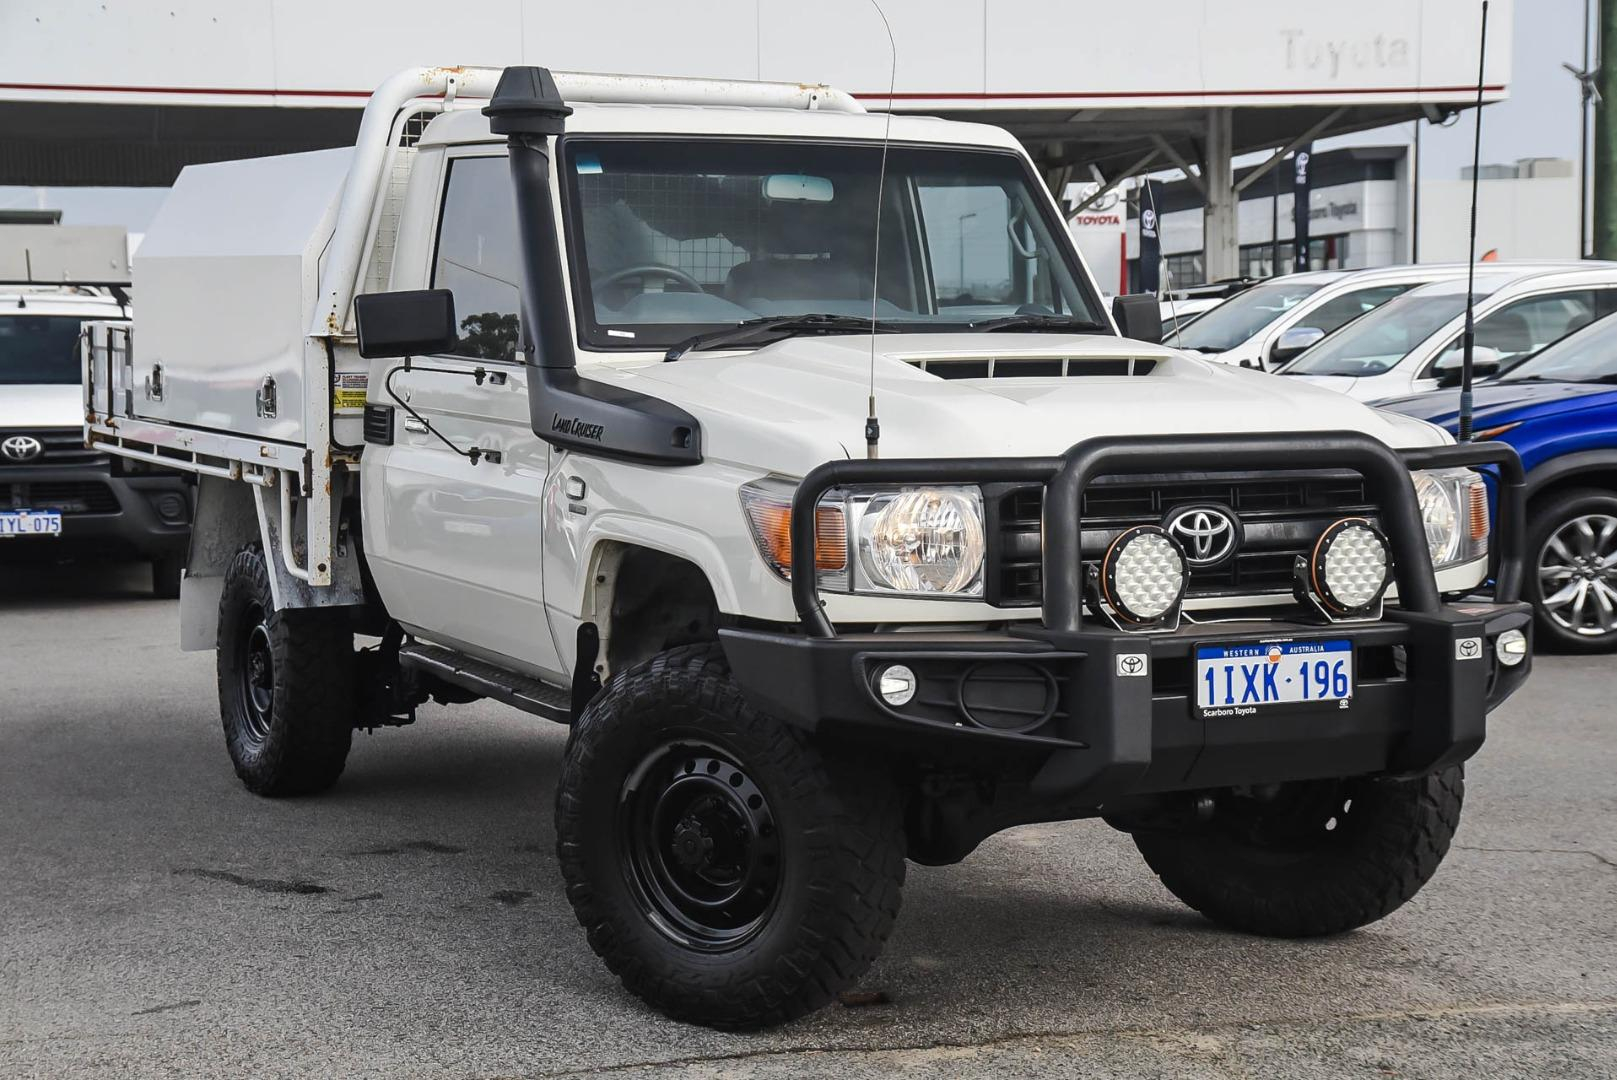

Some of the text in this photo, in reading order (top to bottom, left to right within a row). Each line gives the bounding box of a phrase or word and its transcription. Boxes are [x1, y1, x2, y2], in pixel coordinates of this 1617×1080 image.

[1076, 215, 1120, 226] TOYOTA
[34, 517, 60, 532] 075
[1223, 645, 1325, 658] WESTERN AUSTRALIA
[1205, 659, 1348, 706] 1IXK 196
[1203, 706, 1257, 718] Scarboro Toyota
